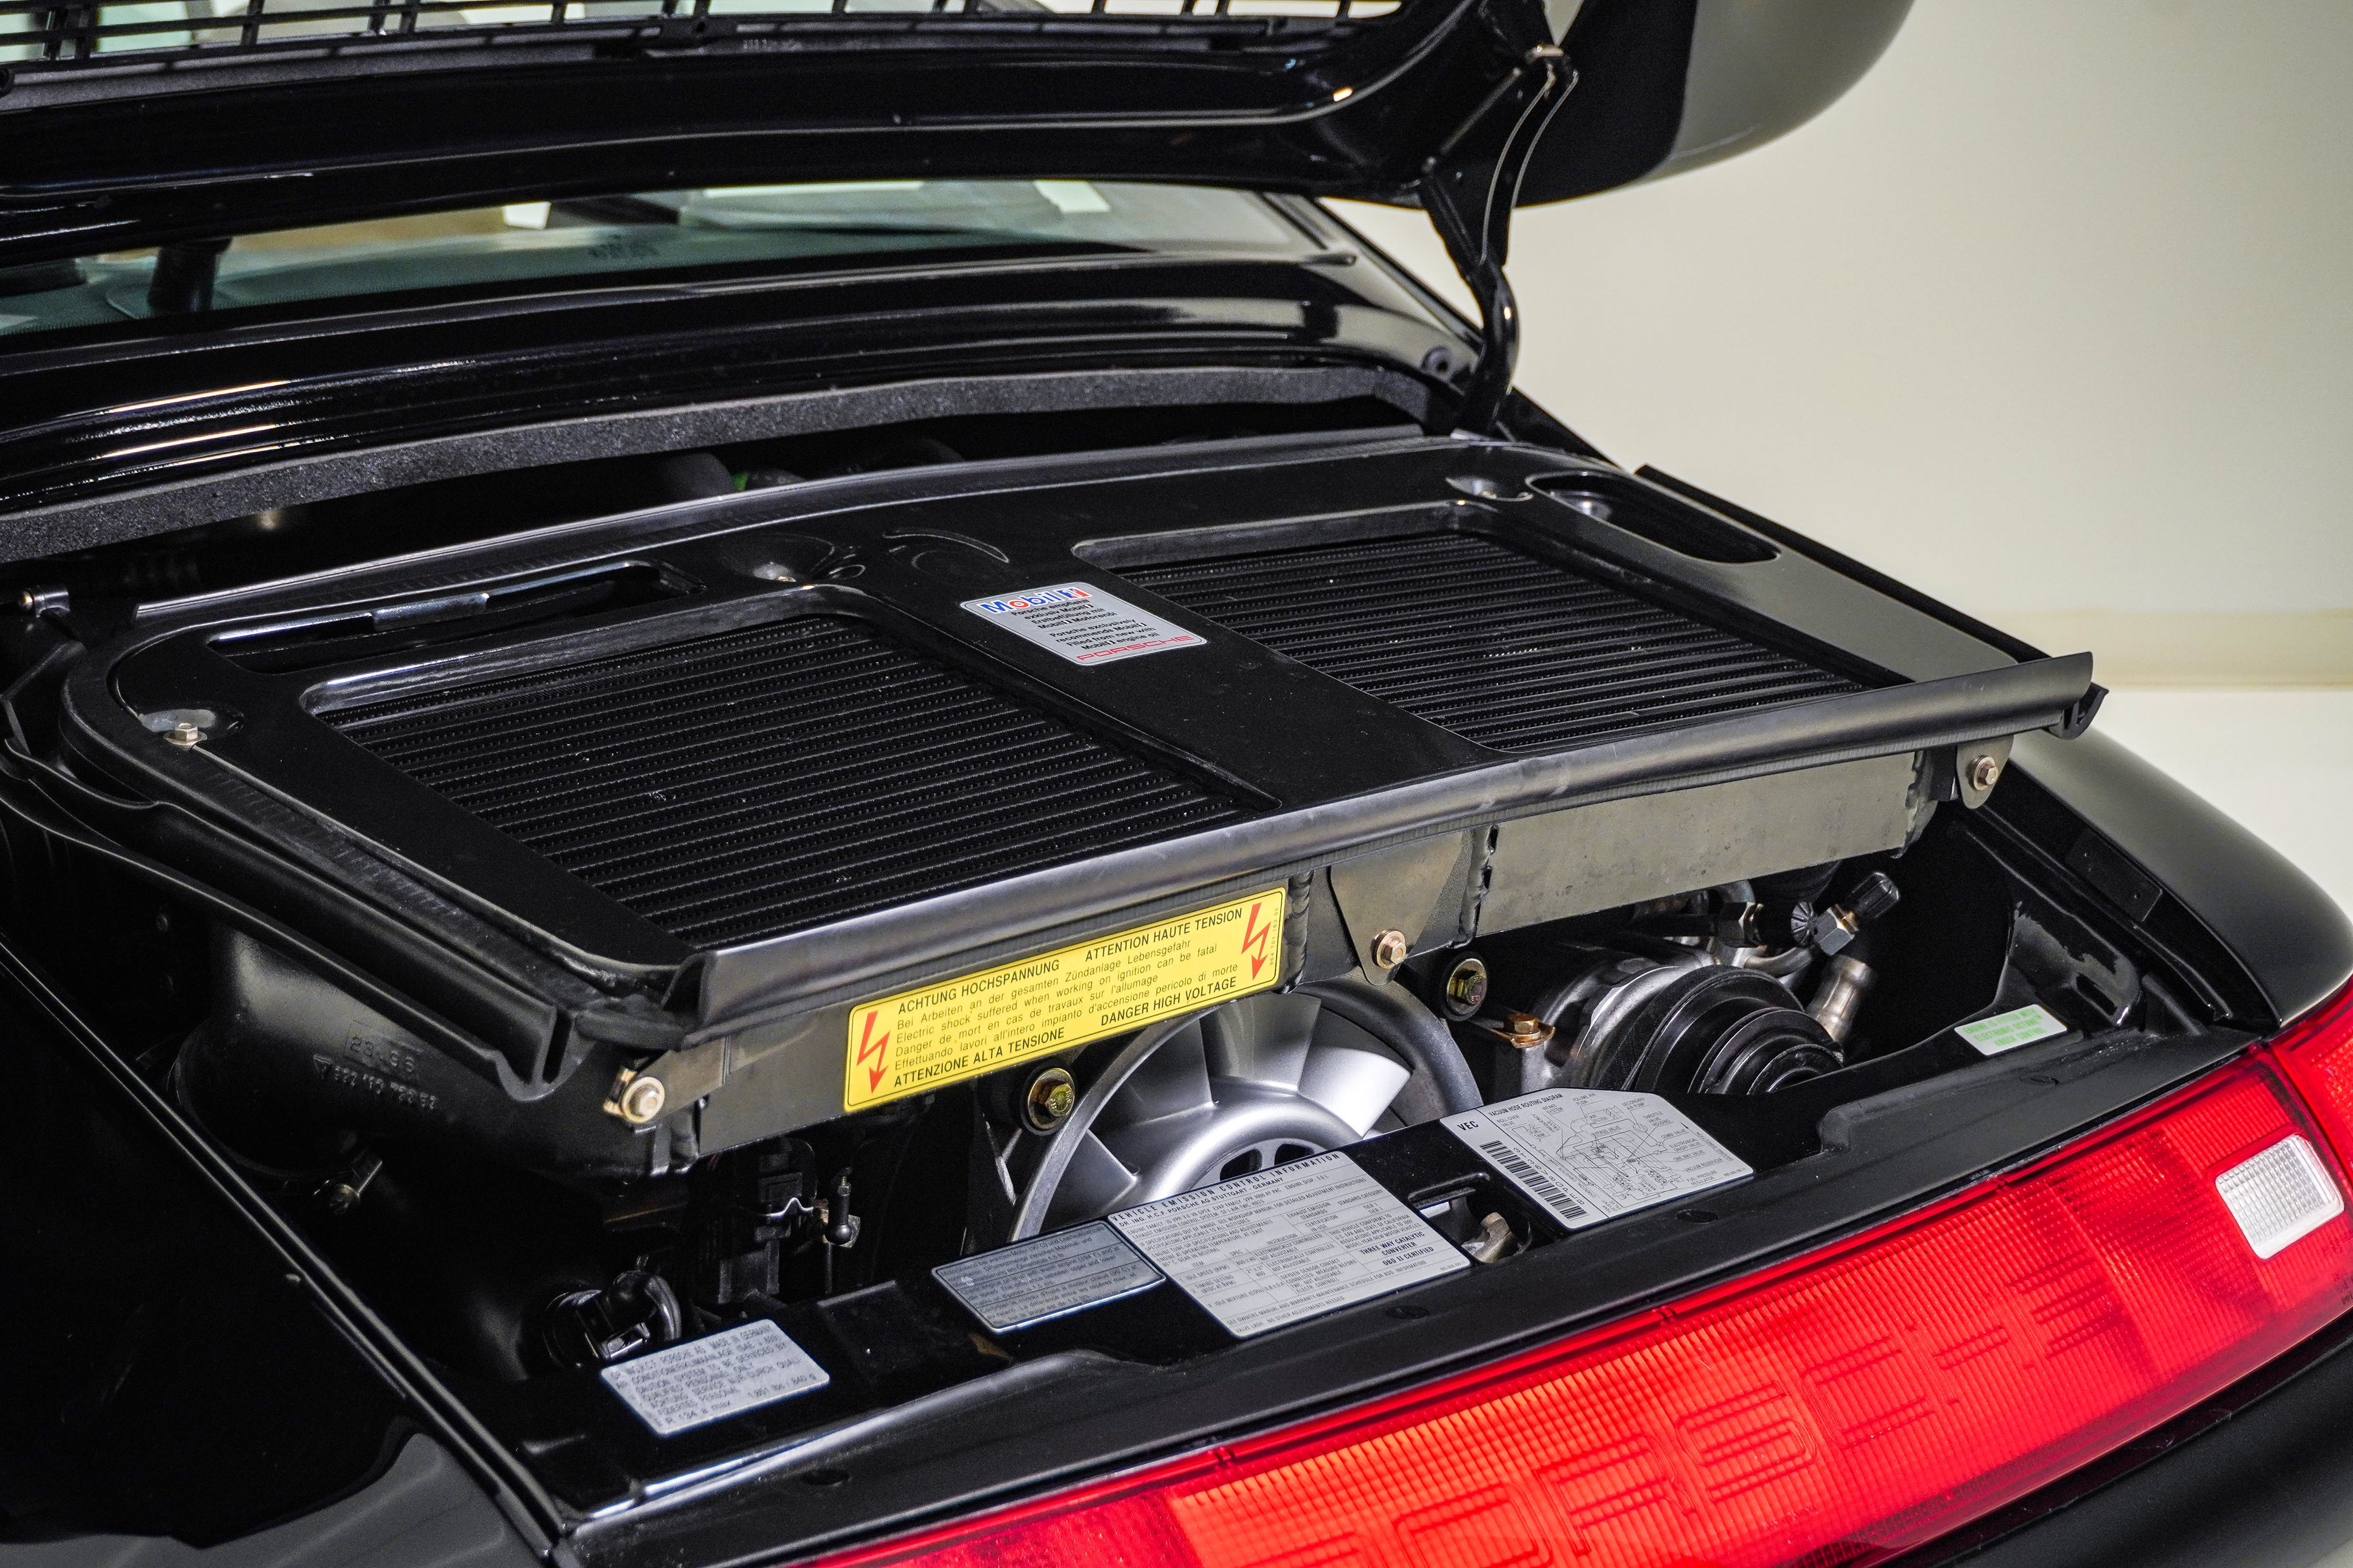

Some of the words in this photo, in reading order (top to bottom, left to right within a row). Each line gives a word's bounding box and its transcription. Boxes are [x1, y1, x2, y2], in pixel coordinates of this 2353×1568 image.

[978, 592, 1063, 612] Mobil
[1009, 607, 1050, 616] Porsche
[1047, 599, 1092, 609] empfiehlt
[1021, 610, 1062, 619] exklusiv
[1030, 611, 1092, 624] Erstbefüllung
[1070, 612, 1118, 622] Motorenöl
[1048, 627, 1089, 637] Porsche
[1085, 618, 1138, 630] exclusively
[1052, 628, 1116, 642] recommends
[1074, 635, 1194, 660] PORSCHE
[1114, 634, 1149, 643] engine
[1274, 906, 1278, 917] 00
[1085, 933, 1149, 961] ATTENTION
[1154, 922, 1190, 943] HAUTE
[1194, 907, 1241, 930] TENSION
[896, 1024, 934, 1044] Electric
[942, 1014, 970, 1030] shock
[977, 1000, 1017, 1021] suffered
[1024, 991, 1049, 1007] when
[1056, 979, 1093, 999] working
[1099, 975, 1110, 985] on
[1117, 962, 1151, 982] ignition
[1157, 957, 1173, 968] can
[1180, 951, 1191, 962] be
[1197, 943, 1217, 957] fatal
[897, 1017, 913, 1030] Bei
[921, 1003, 963, 1023] Arbeiten
[970, 999, 981, 1009] an
[989, 991, 1004, 1004] der
[1011, 976, 1058, 1000] gesamten
[1066, 958, 1121, 984] Zündanlage
[1128, 938, 1190, 966] Lebensgefahr
[898, 987, 957, 1014] ACHTUNG
[962, 959, 1059, 997] HOCHSPANNUNG
[1101, 1002, 1149, 1026] DANGER
[1153, 992, 1180, 1011] HIGH
[1185, 976, 1236, 1001] VOLTAGE
[894, 1045, 953, 1071] Effettuando
[960, 1036, 987, 1052] lavori
[994, 1021, 1035, 1042] all'intero
[1042, 1007, 1082, 1030] impianto
[1089, 988, 1150, 1014] d'accensione
[1156, 975, 1192, 996] pericolo
[1198, 971, 1206, 982] di
[1213, 963, 1237, 977] morte
[896, 1038, 932, 1059] Danger
[939, 1032, 951, 1044] de
[959, 1024, 981, 1039] mort
[988, 1021, 999, 1030] en
[1006, 1014, 1023, 1025] cas
[1030, 1007, 1041, 1018] de
[1048, 995, 1083, 1013] travaux
[1090, 989, 1105, 1001] sur
[1110, 973, 1158, 997] l'allumage
[894, 1055, 969, 1087] ATTENZIONE
[973, 1045, 1003, 1064] ALTA
[1008, 1027, 1064, 1053] TENSIONE
[1487, 1107, 1510, 1117] VACUUM
[1520, 1099, 1542, 1108] ROUTING
[1540, 1093, 1564, 1102] DIAGRAM
[1456, 1120, 1479, 1131] VEC
[1110, 1204, 1158, 1222] VEHICLE
[1160, 1188, 1216, 1207] EMISSION
[1218, 1174, 1267, 1191] CONTROL
[1268, 1153, 1340, 1176] INFORMATION
[1166, 1201, 1200, 1213] PORSCHE
[1210, 1187, 1248, 1200] STUTTGART
[1251, 1177, 1285, 1189] GERMANY
[1337, 1195, 1362, 1205] STANDARD
[1360, 1189, 1384, 1198] CATEGORY
[1286, 1208, 1309, 1218] EXHAUST
[1306, 1202, 1332, 1211] EMISSION
[1299, 1208, 1328, 1219] STANDARDS
[1383, 1214, 1411, 1225] CALIFORNIA
[1303, 1214, 1339, 1227] CERTIFICATION
[1340, 1223, 1360, 1231] VEHICLE
[1359, 1215, 1386, 1226] CONFORMS
[1151, 1249, 1171, 1257] ENGINE
[1191, 1231, 1230, 1246] SPECIFICATIONS
[1238, 1219, 1275, 1232] ADJUSTMENTS
[1338, 1231, 1372, 1244] REGULATIONS
[1370, 1224, 1397, 1234] APPLICABLE
[1344, 1241, 1364, 1249] MODEL
[1383, 1229, 1401, 1237] MOTOR
[1359, 1245, 1382, 1254] THREE
[1379, 1240, 1397, 1248] WAY
[1394, 1231, 1426, 1243] CATALYTIC
[1380, 1241, 1418, 1256] CONVERTER
[1402, 1246, 1434, 1258] CERTIFIED
